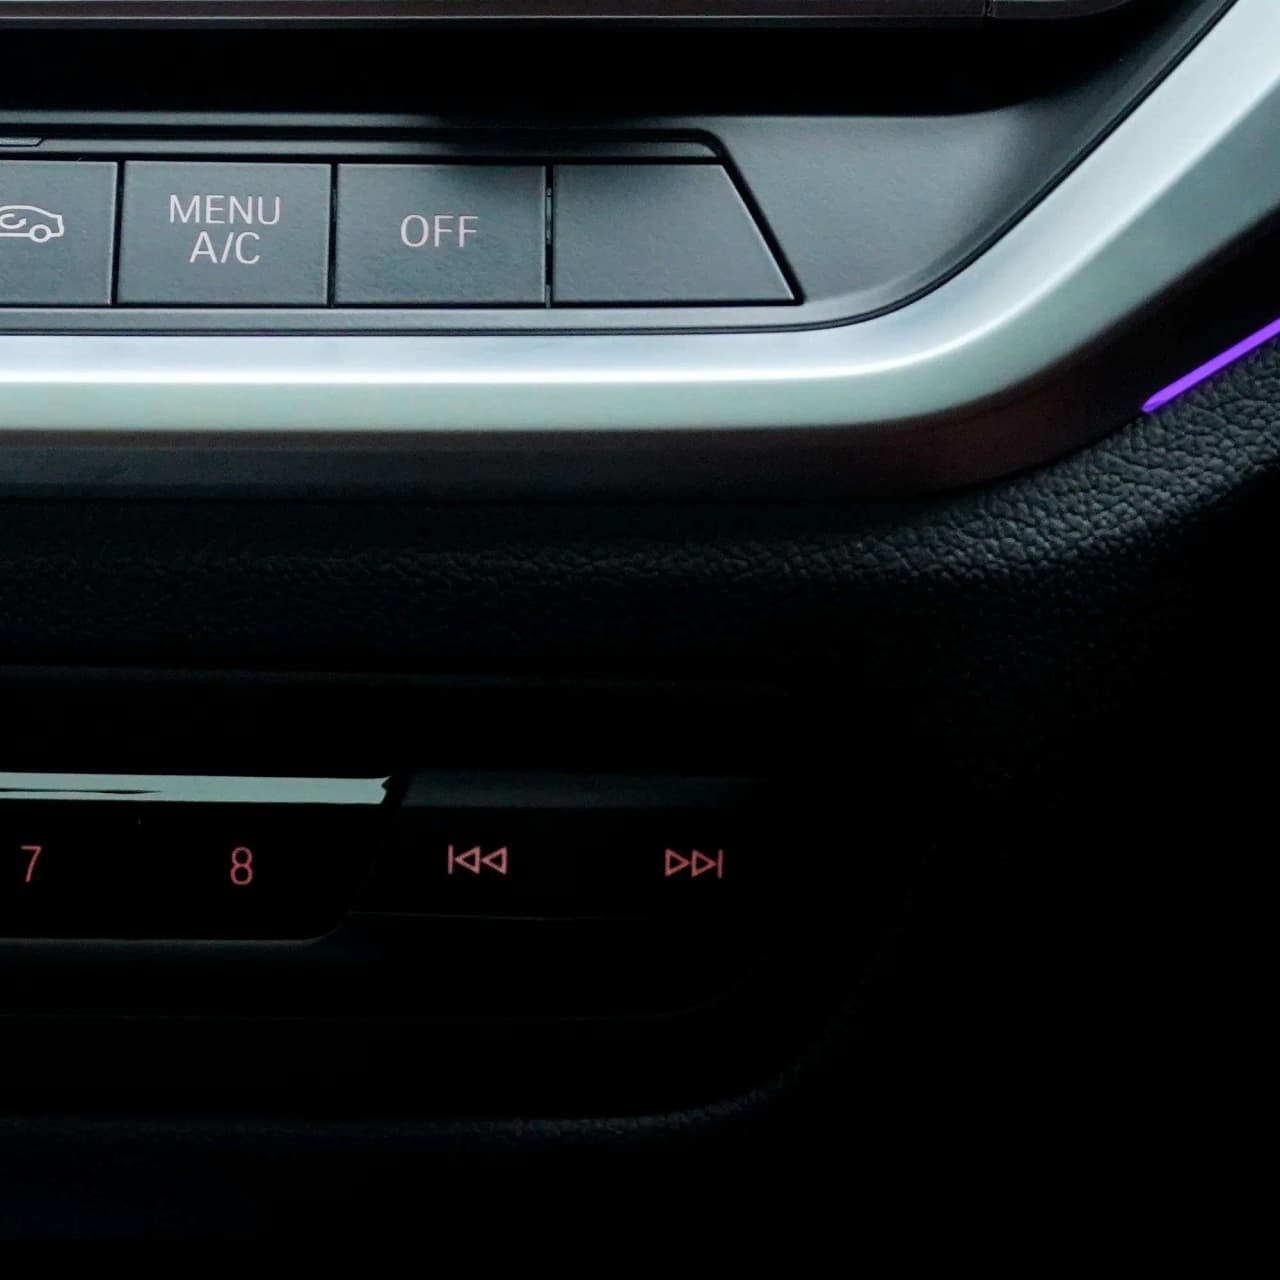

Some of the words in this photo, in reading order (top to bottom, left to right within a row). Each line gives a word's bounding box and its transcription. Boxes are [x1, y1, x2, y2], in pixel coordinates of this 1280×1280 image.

[169, 194, 281, 225] MENU
[189, 231, 261, 265] A/C
[400, 214, 479, 248] OFF
[20, 844, 42, 883] 7
[229, 846, 254, 886] 8
